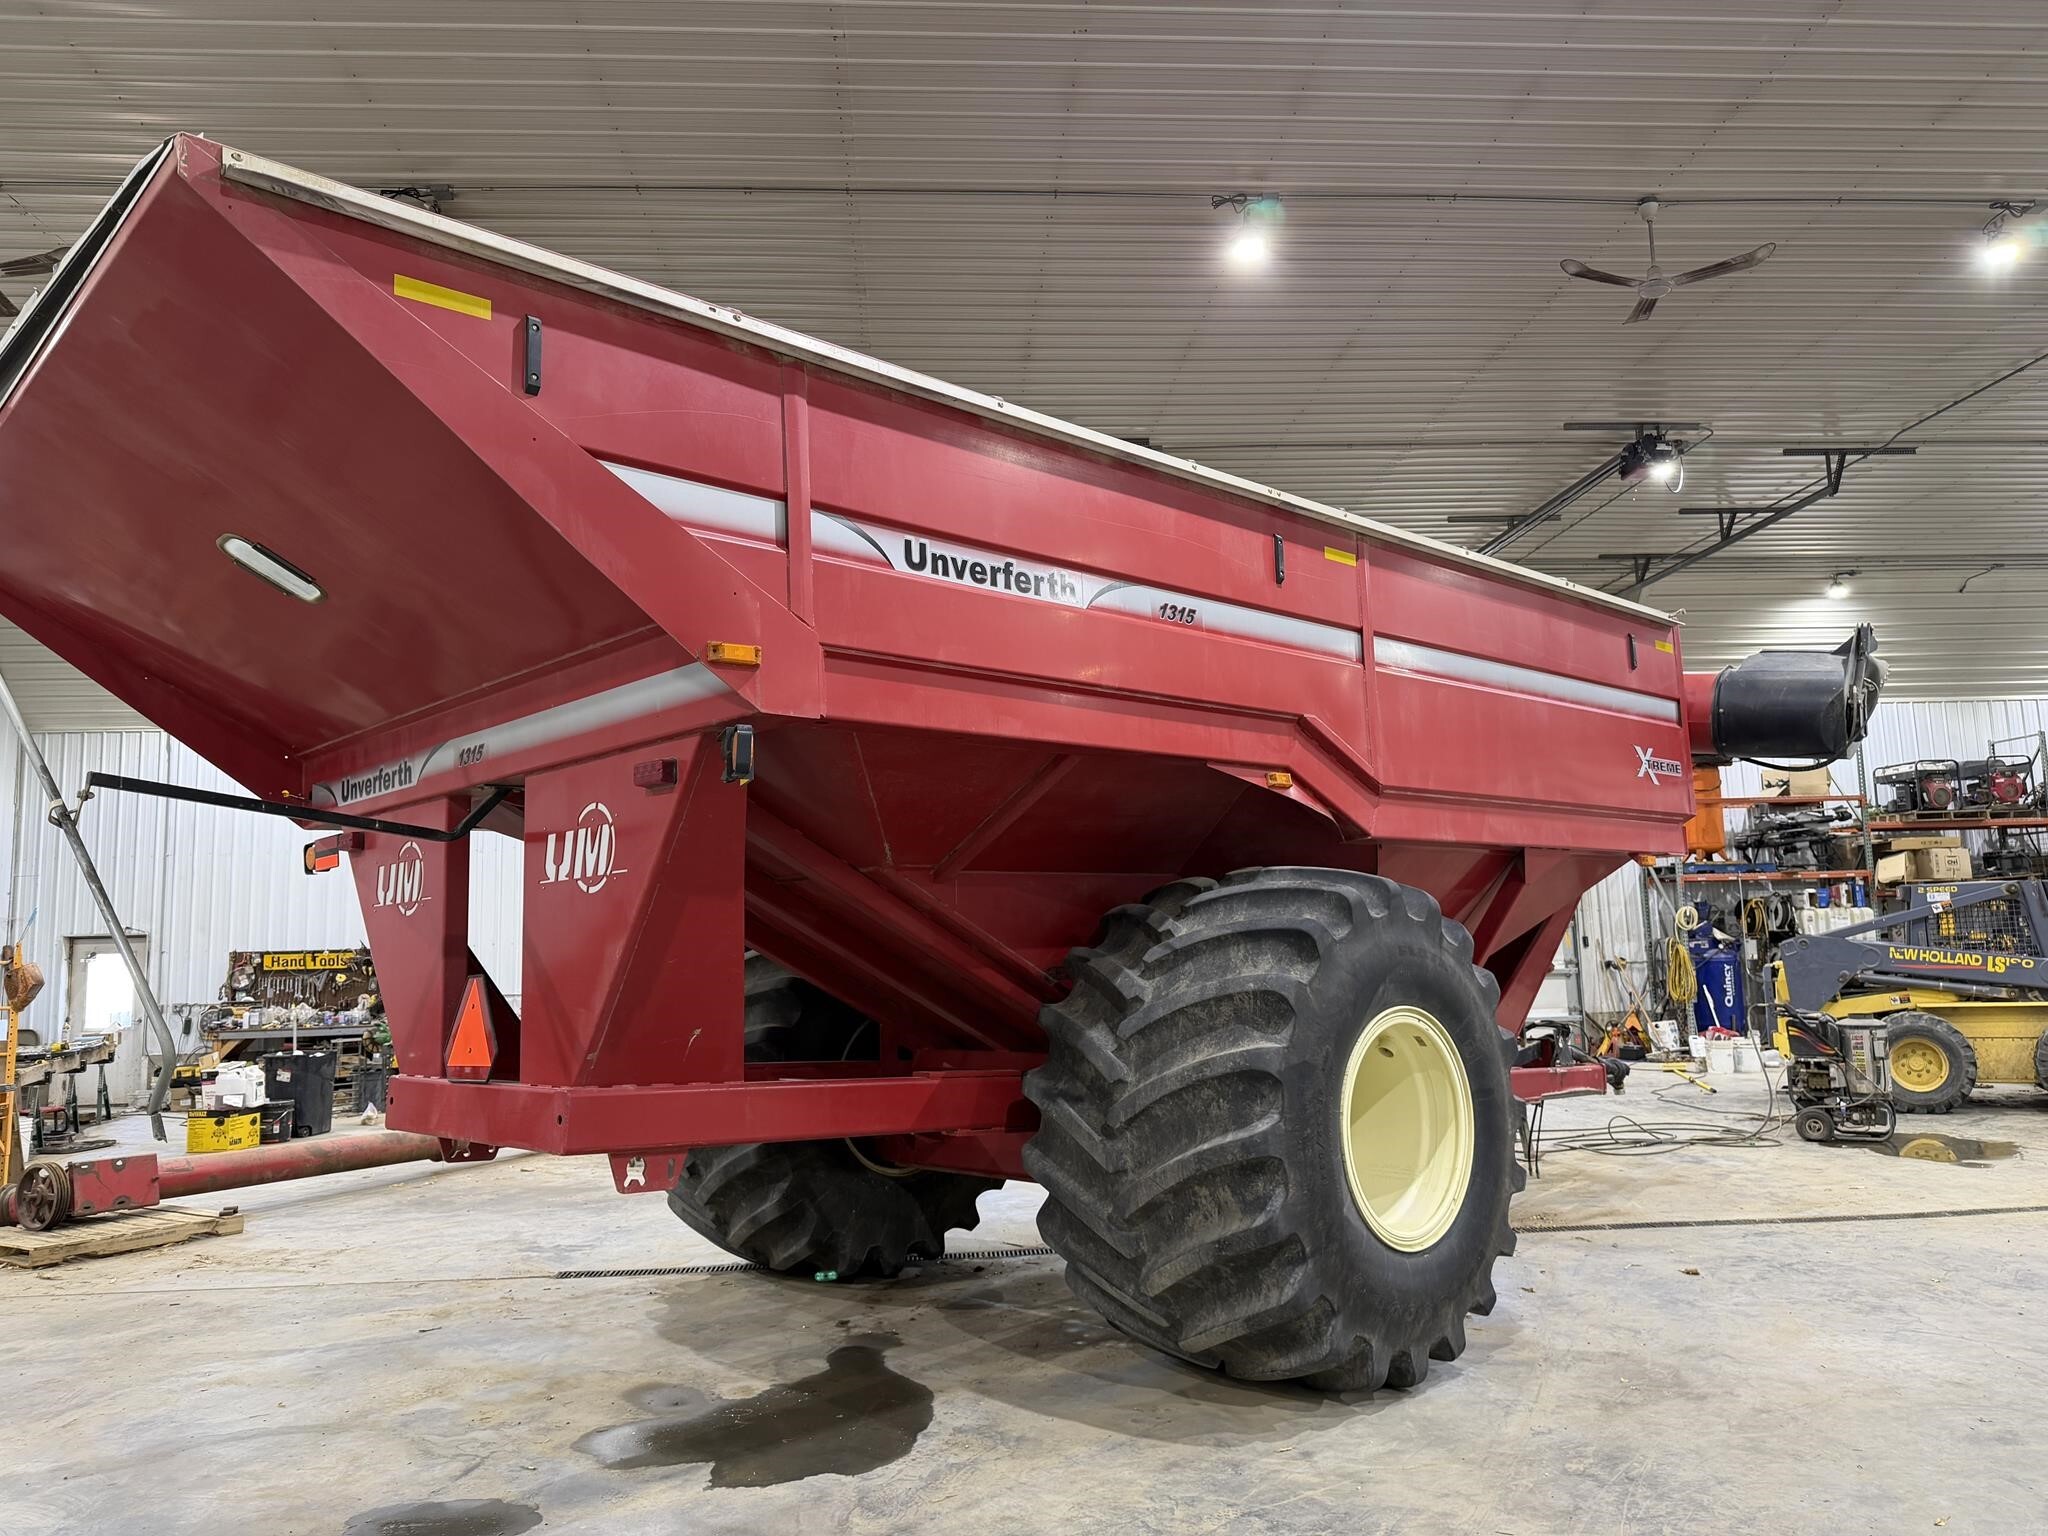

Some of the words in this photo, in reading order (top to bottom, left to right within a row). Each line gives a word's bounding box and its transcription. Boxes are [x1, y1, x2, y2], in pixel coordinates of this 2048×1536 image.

[903, 538, 1077, 601] Unverferth
[1158, 602, 1197, 625] 1315
[458, 743, 485, 768] 1315
[341, 760, 413, 802] Unverferth
[271, 956, 305, 968] Hand
[311, 954, 347, 967] Tools
[1919, 949, 1982, 966] HOLLAND
